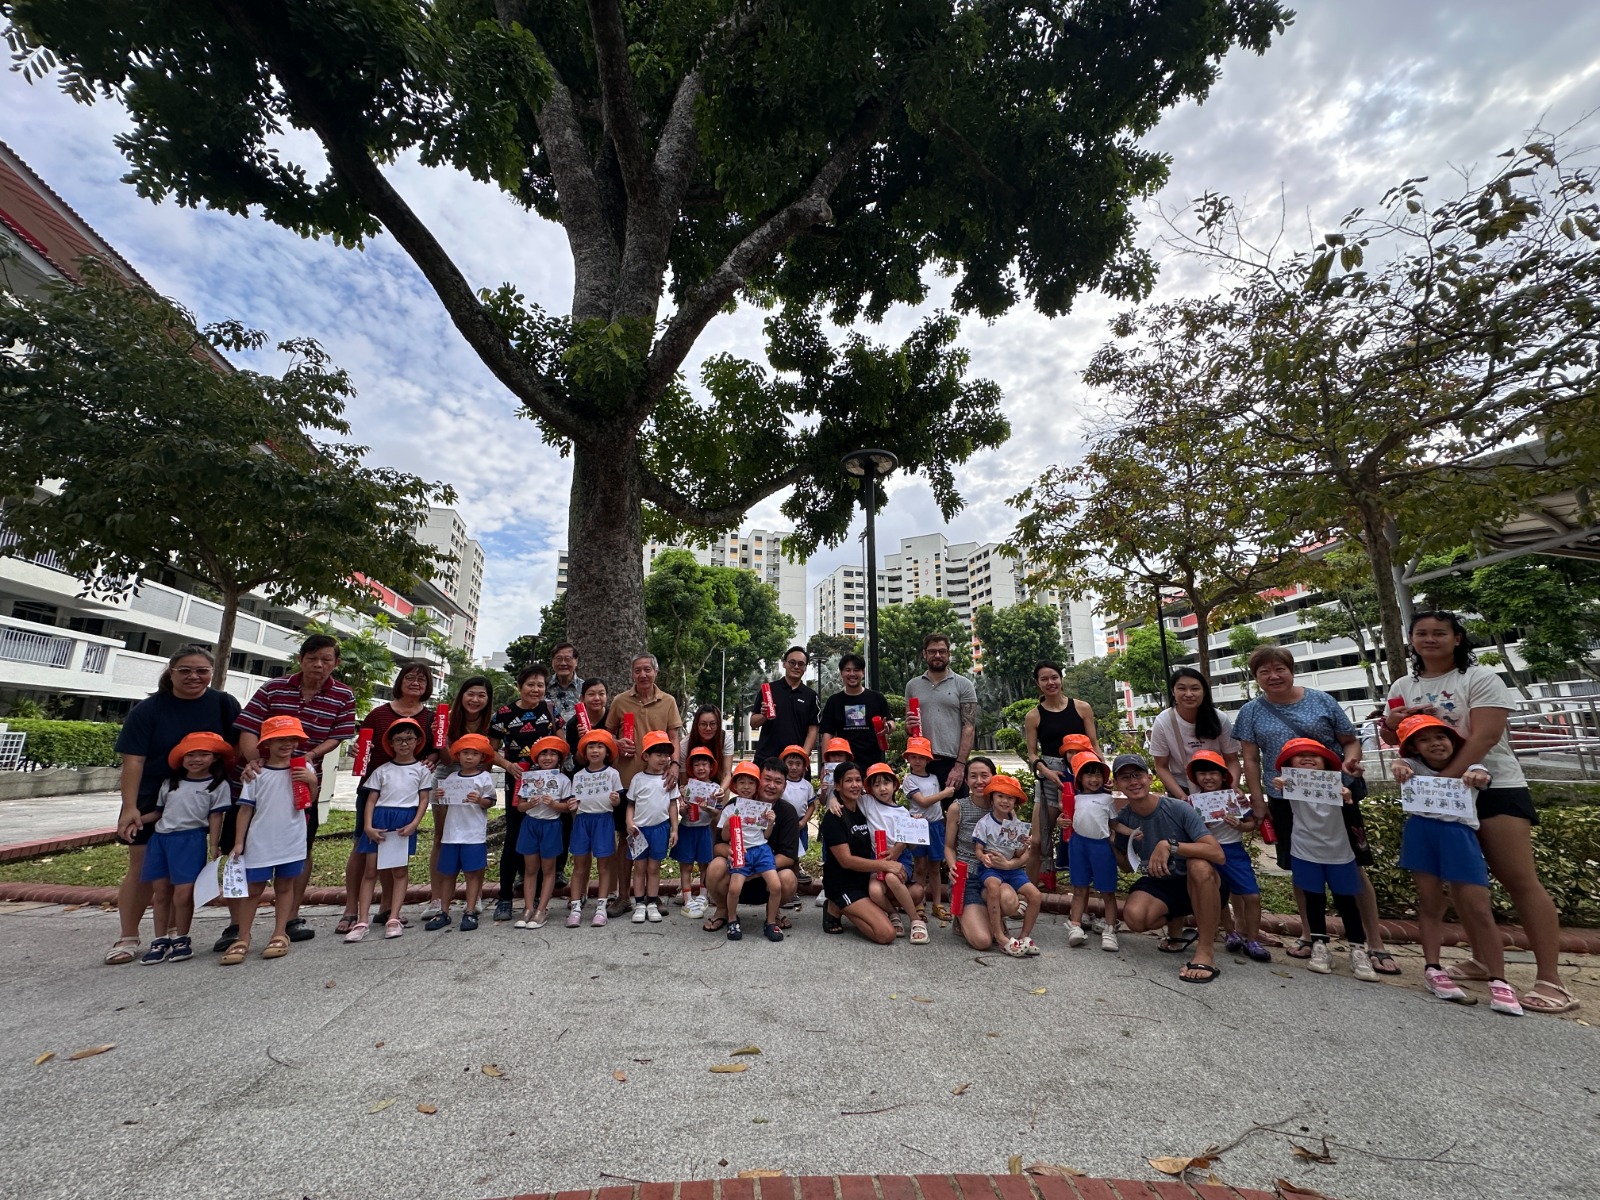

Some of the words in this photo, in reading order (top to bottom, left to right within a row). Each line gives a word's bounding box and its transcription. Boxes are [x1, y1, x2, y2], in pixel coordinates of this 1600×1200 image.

[436, 714, 446, 747] EcoGuard
[360, 740, 372, 776] EcoGuard
[1291, 769, 1308, 779] Fire
[1310, 771, 1340, 786] Safety
[1297, 779, 1333, 789] Heroes
[1410, 777, 1430, 787] Fire
[1416, 786, 1460, 798] Heroes
[734, 827, 744, 865] EcoGuard
